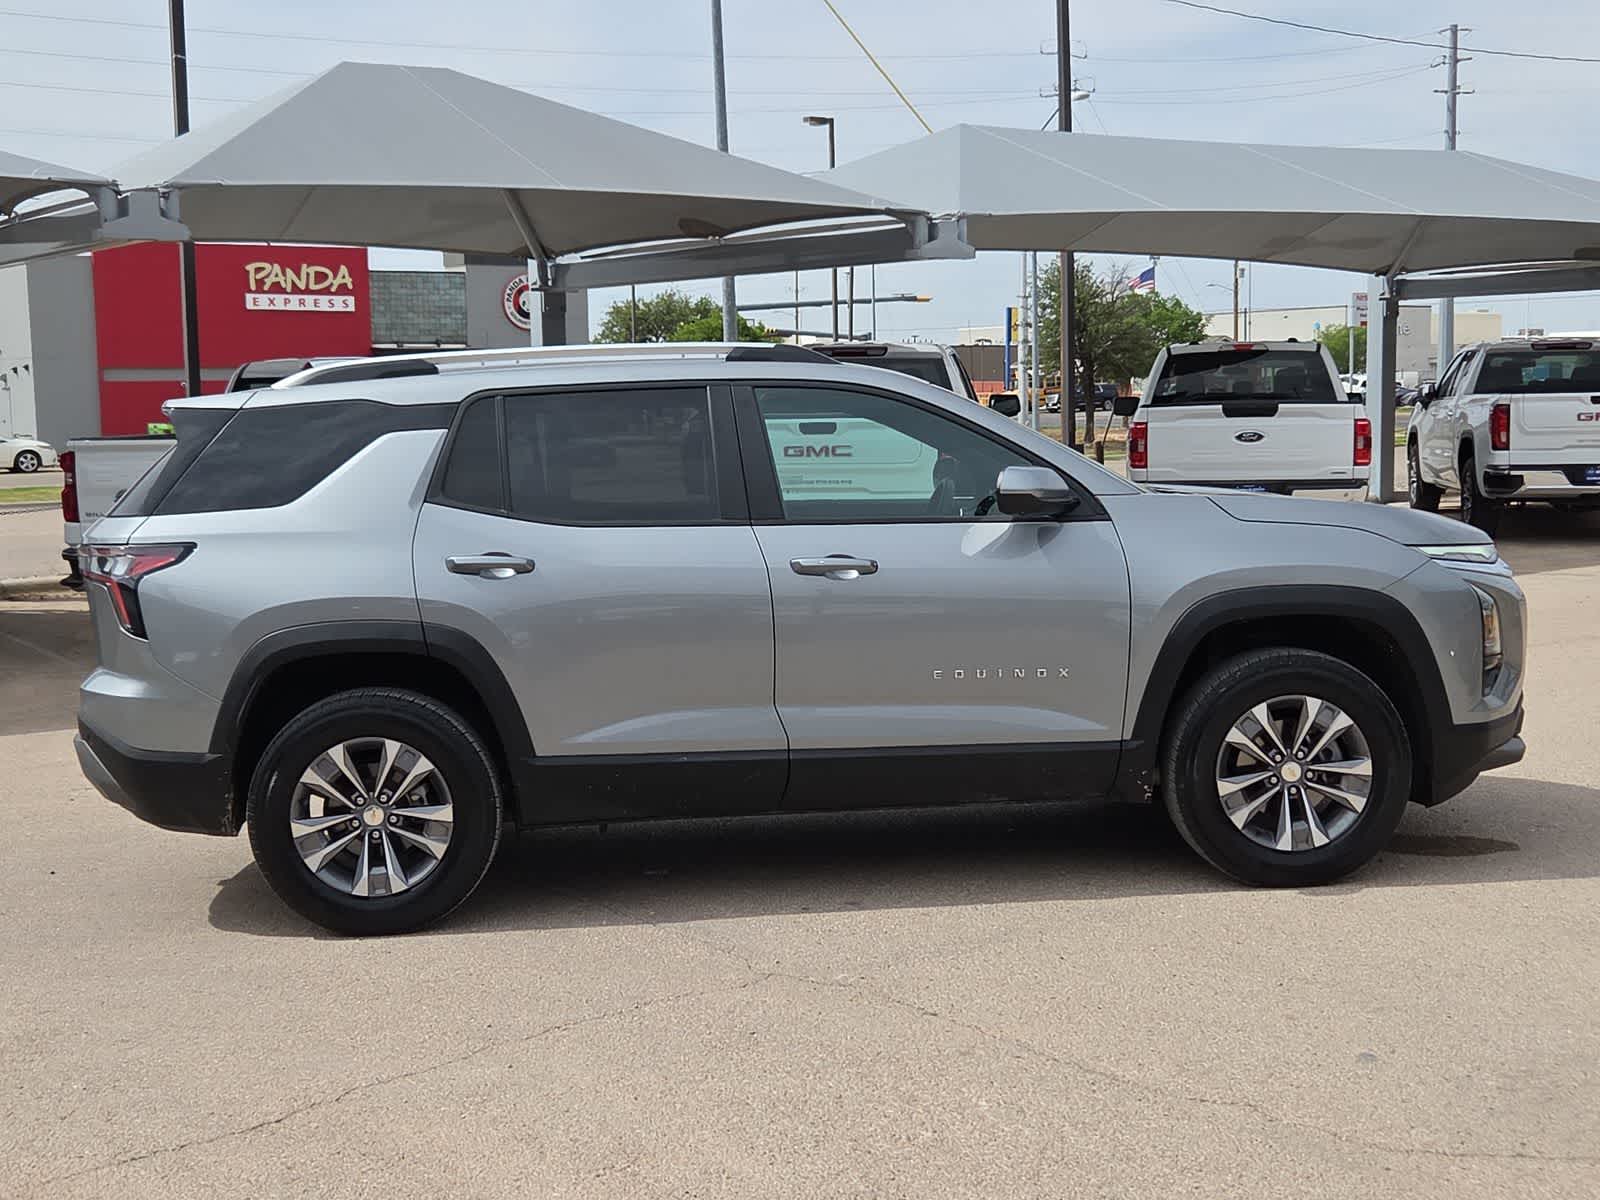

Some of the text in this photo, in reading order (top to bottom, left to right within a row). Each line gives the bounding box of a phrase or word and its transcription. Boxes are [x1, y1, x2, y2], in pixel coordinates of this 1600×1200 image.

[245, 262, 353, 293] PANDA
[506, 278, 525, 303] PANDA
[252, 296, 351, 309] EXPRESS
[783, 445, 853, 458] GMC
[933, 667, 1070, 680] EQUINOX
